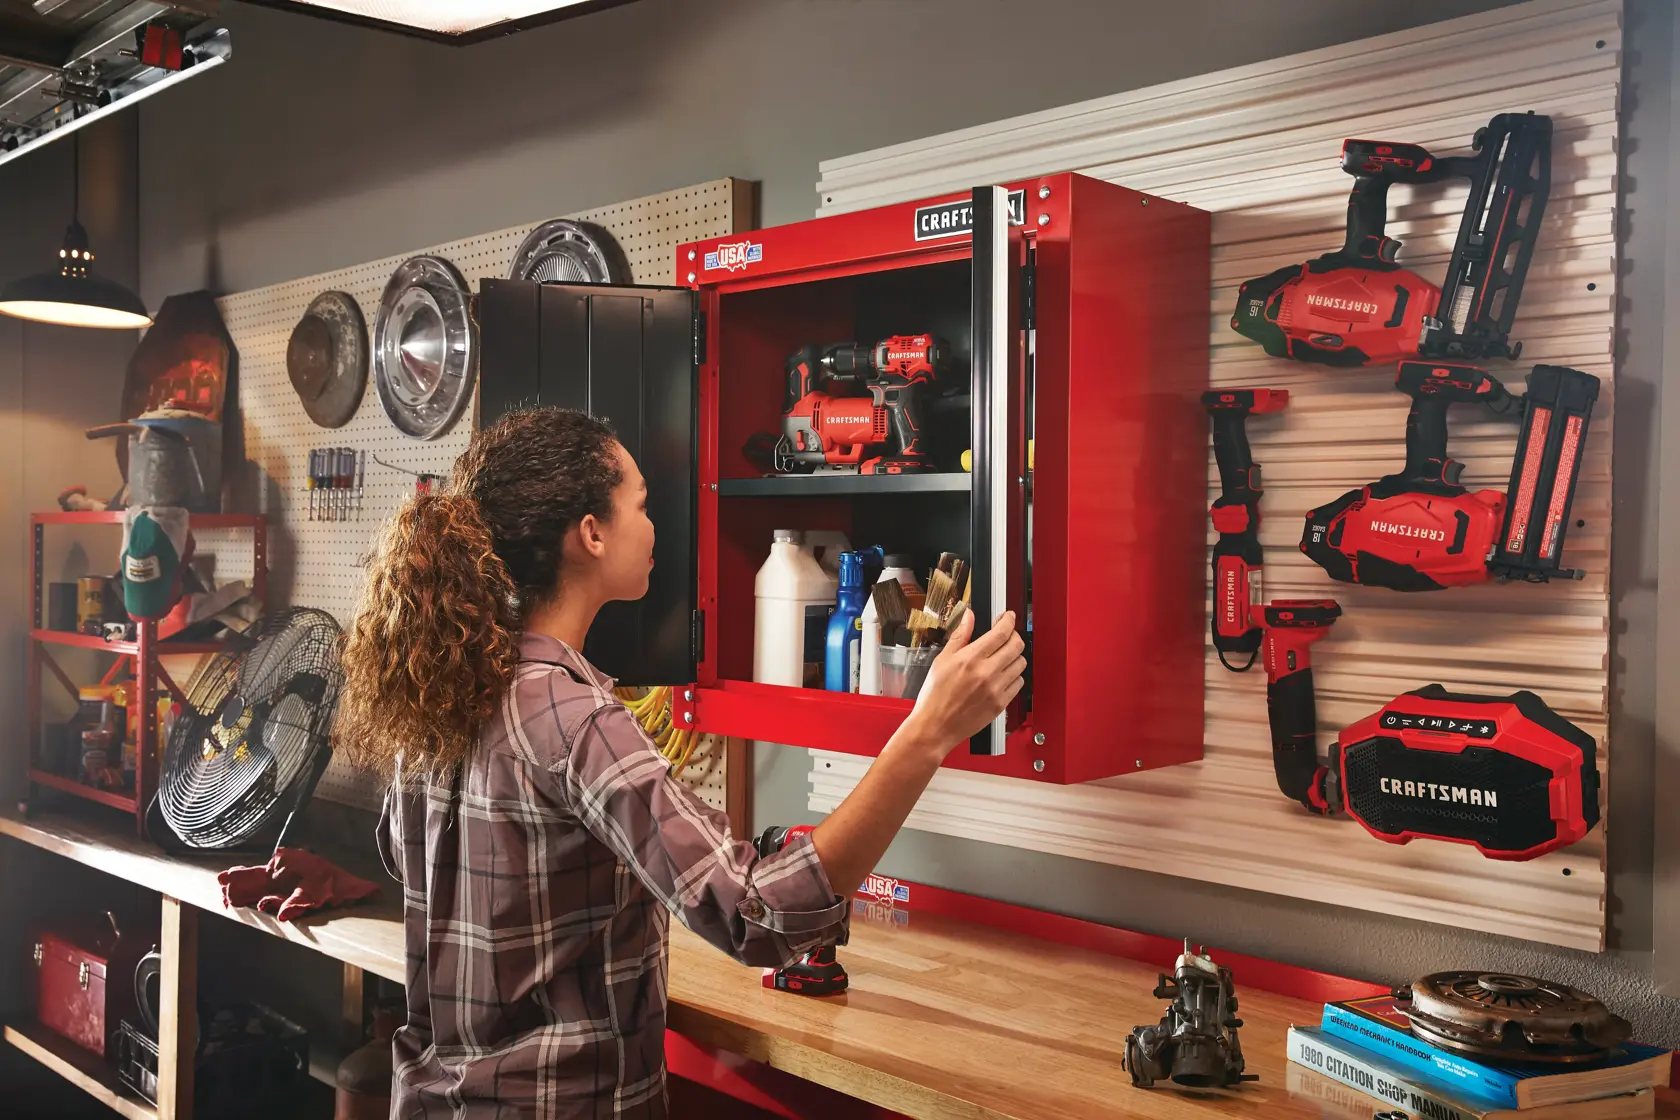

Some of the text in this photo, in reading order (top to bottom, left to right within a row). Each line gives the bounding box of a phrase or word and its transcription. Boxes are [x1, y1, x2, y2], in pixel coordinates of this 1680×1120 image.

[921, 199, 1016, 231] CRAFTN
[720, 246, 745, 265] USA
[1250, 306, 1259, 316] 16
[1306, 294, 1378, 314] CRAFTSMAN
[826, 416, 870, 424] CRAFTSMAN
[1312, 532, 1321, 543] 18
[1370, 520, 1445, 542] CRAFTSMAN
[1227, 571, 1235, 622] CRAFTSMAN
[1380, 777, 1498, 808] CRAFTSMAN
[868, 878, 893, 897] USA
[1330, 1015, 1431, 1061] WEEKEND MECHANIC'S HANDBOOK
[1300, 1043, 1323, 1068] 1980
[1326, 1055, 1374, 1091] CITATION
[1377, 1076, 1408, 1105] SHOP
